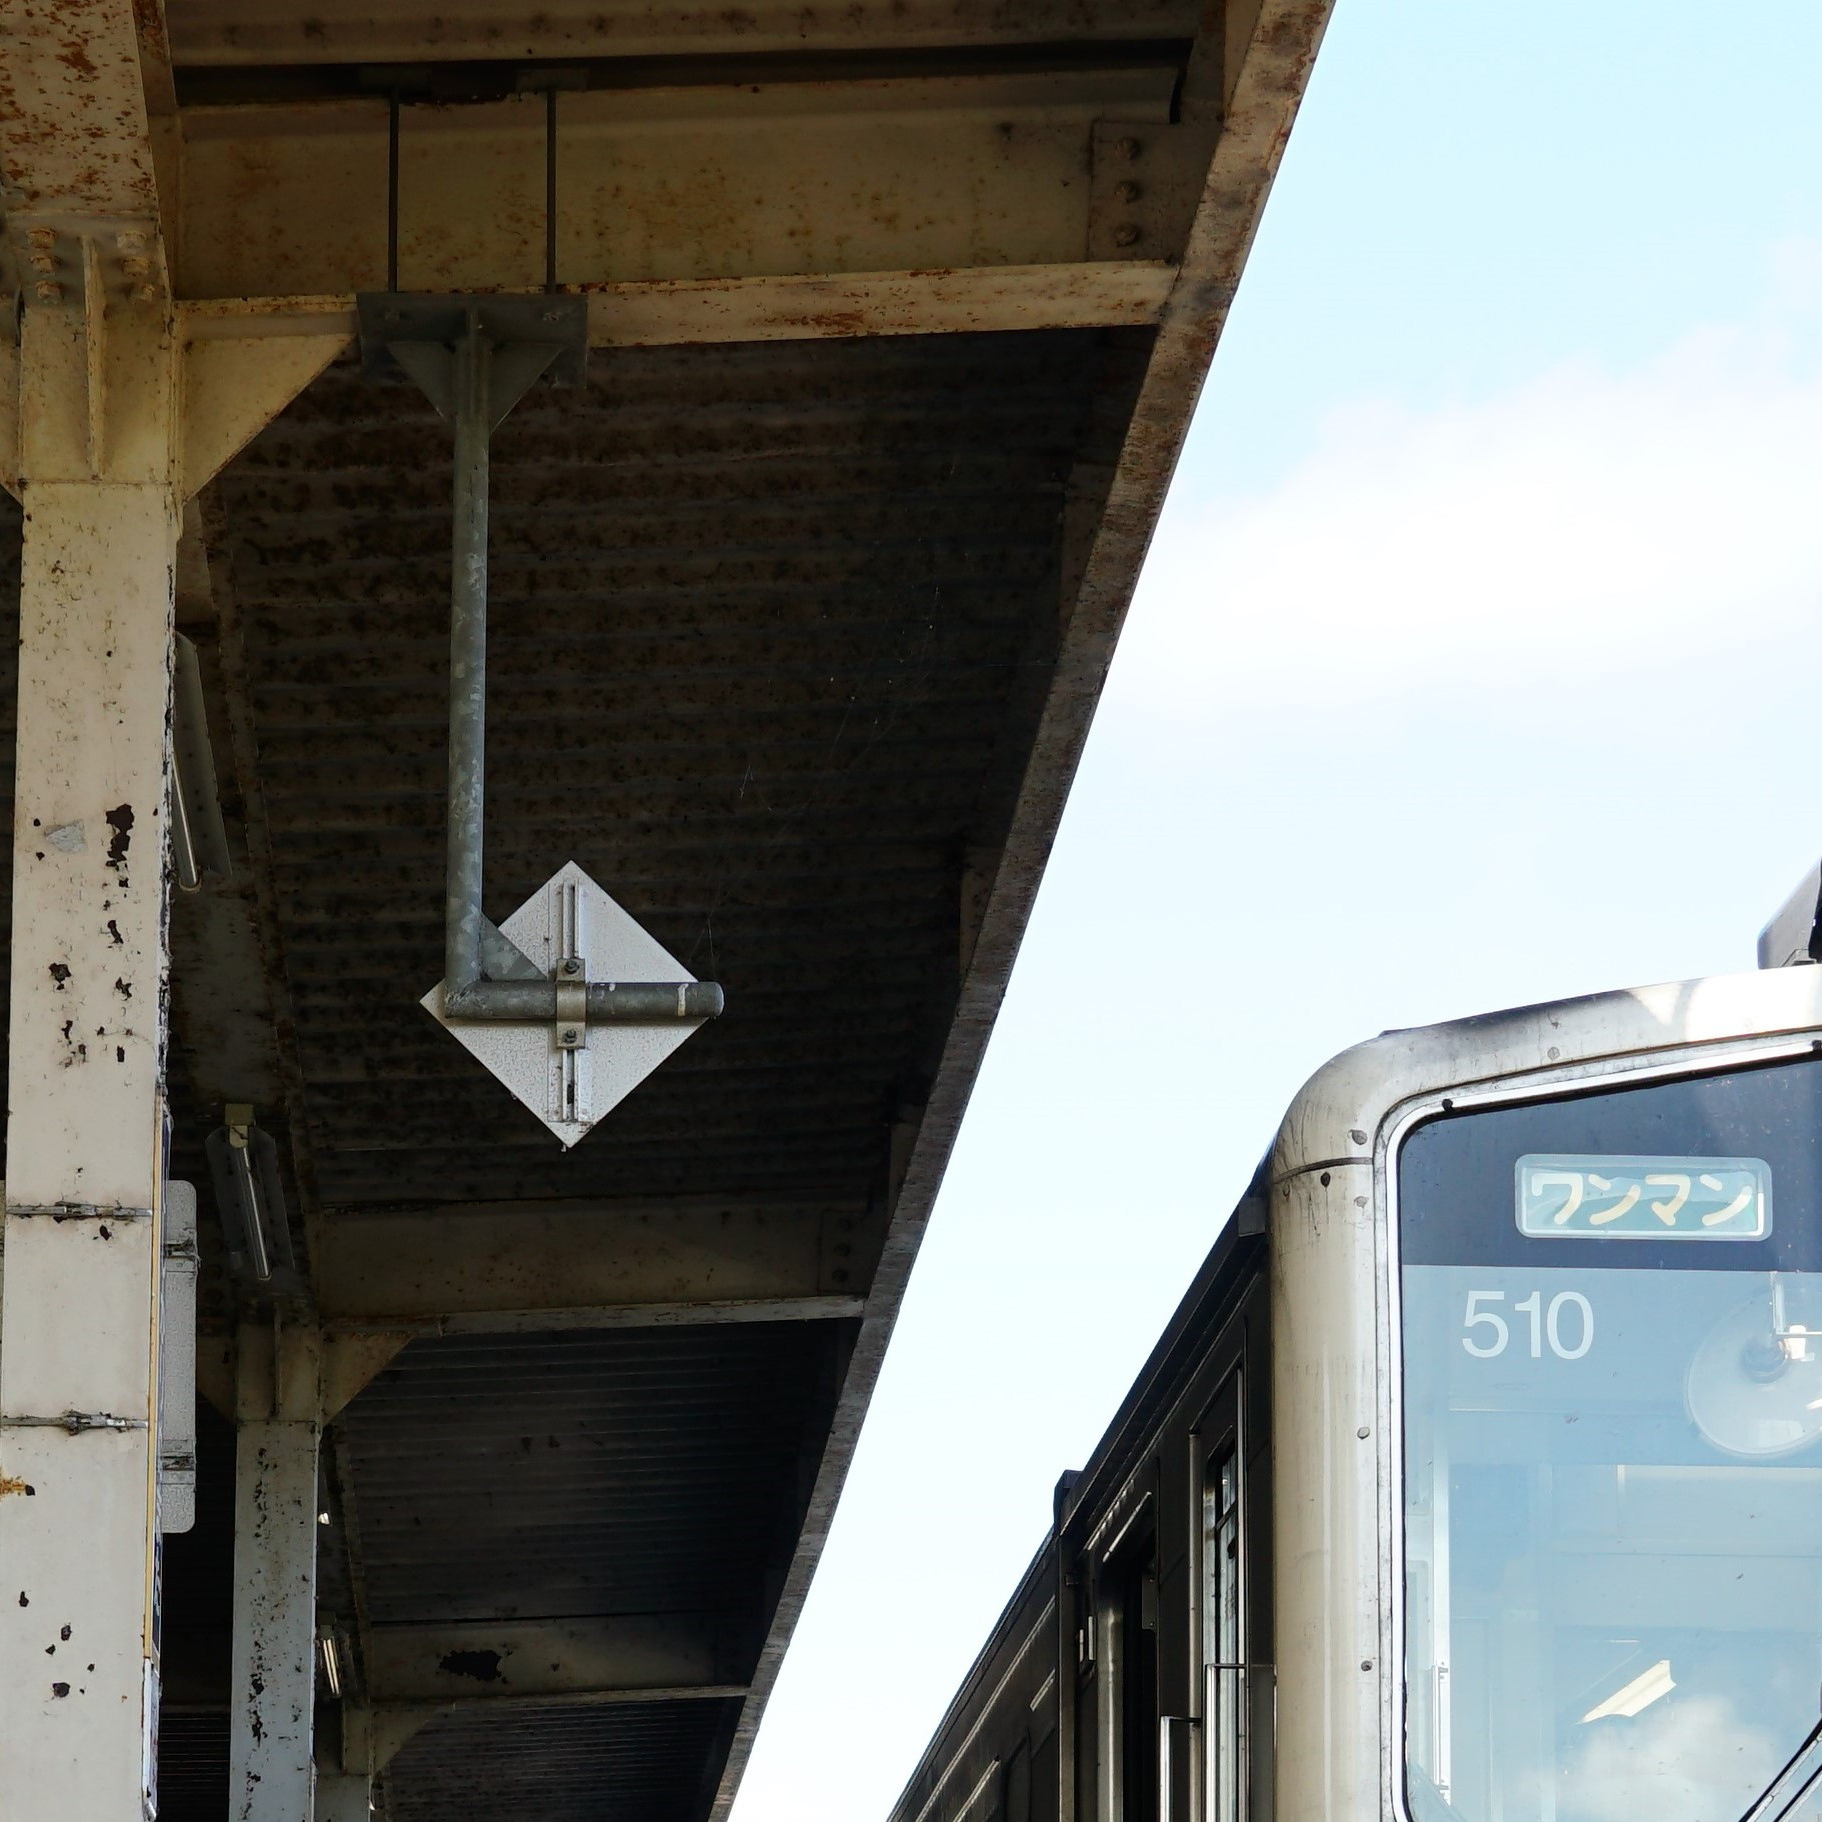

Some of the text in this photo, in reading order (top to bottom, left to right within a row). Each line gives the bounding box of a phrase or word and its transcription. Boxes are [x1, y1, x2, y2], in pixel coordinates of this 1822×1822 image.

[1529, 1174, 1753, 1227] ワンマン
[1461, 1290, 1594, 1360] 510
